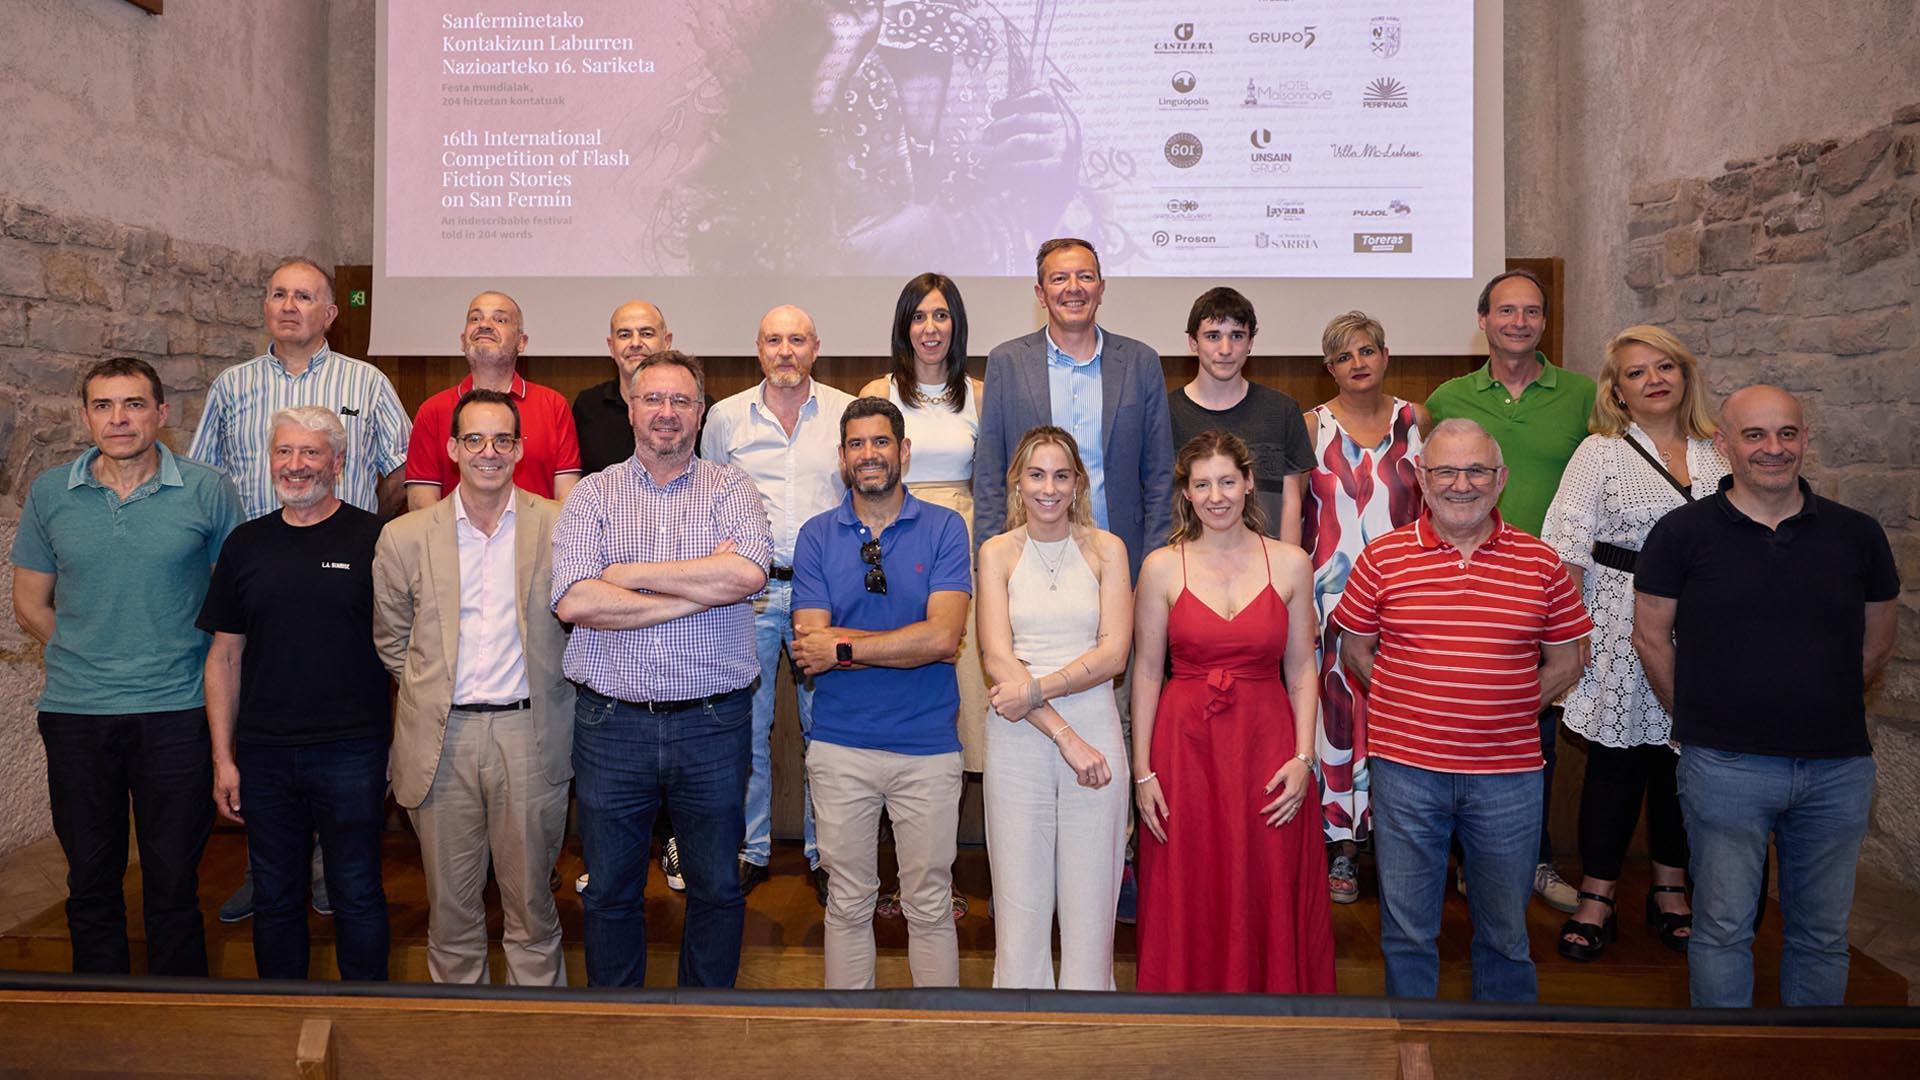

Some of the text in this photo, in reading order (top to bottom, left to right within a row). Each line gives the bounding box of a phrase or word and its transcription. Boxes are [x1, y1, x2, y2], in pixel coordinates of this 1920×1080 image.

[441, 12, 584, 30] Sanferminetako
[442, 34, 634, 52] Kontakizun Laburren
[442, 57, 655, 74] Nazioarteko 16. Sariketa
[441, 82, 534, 94] Festa mundialak,
[441, 95, 565, 106] 204 hitzetan kontatuak
[442, 129, 602, 147] 16th International
[1170, 143, 1196, 156] 601
[441, 149, 630, 170] Competition of Flash
[1251, 153, 1292, 162] UNSAIN
[1250, 163, 1290, 174] GRUPO
[442, 170, 572, 188] Fiction Stories
[441, 189, 573, 208] on San Fermín
[441, 215, 573, 226] An indescribable festival
[441, 229, 533, 241] told in 204 words
[1175, 234, 1216, 243] Prosan
[1361, 235, 1404, 245] Toreras
